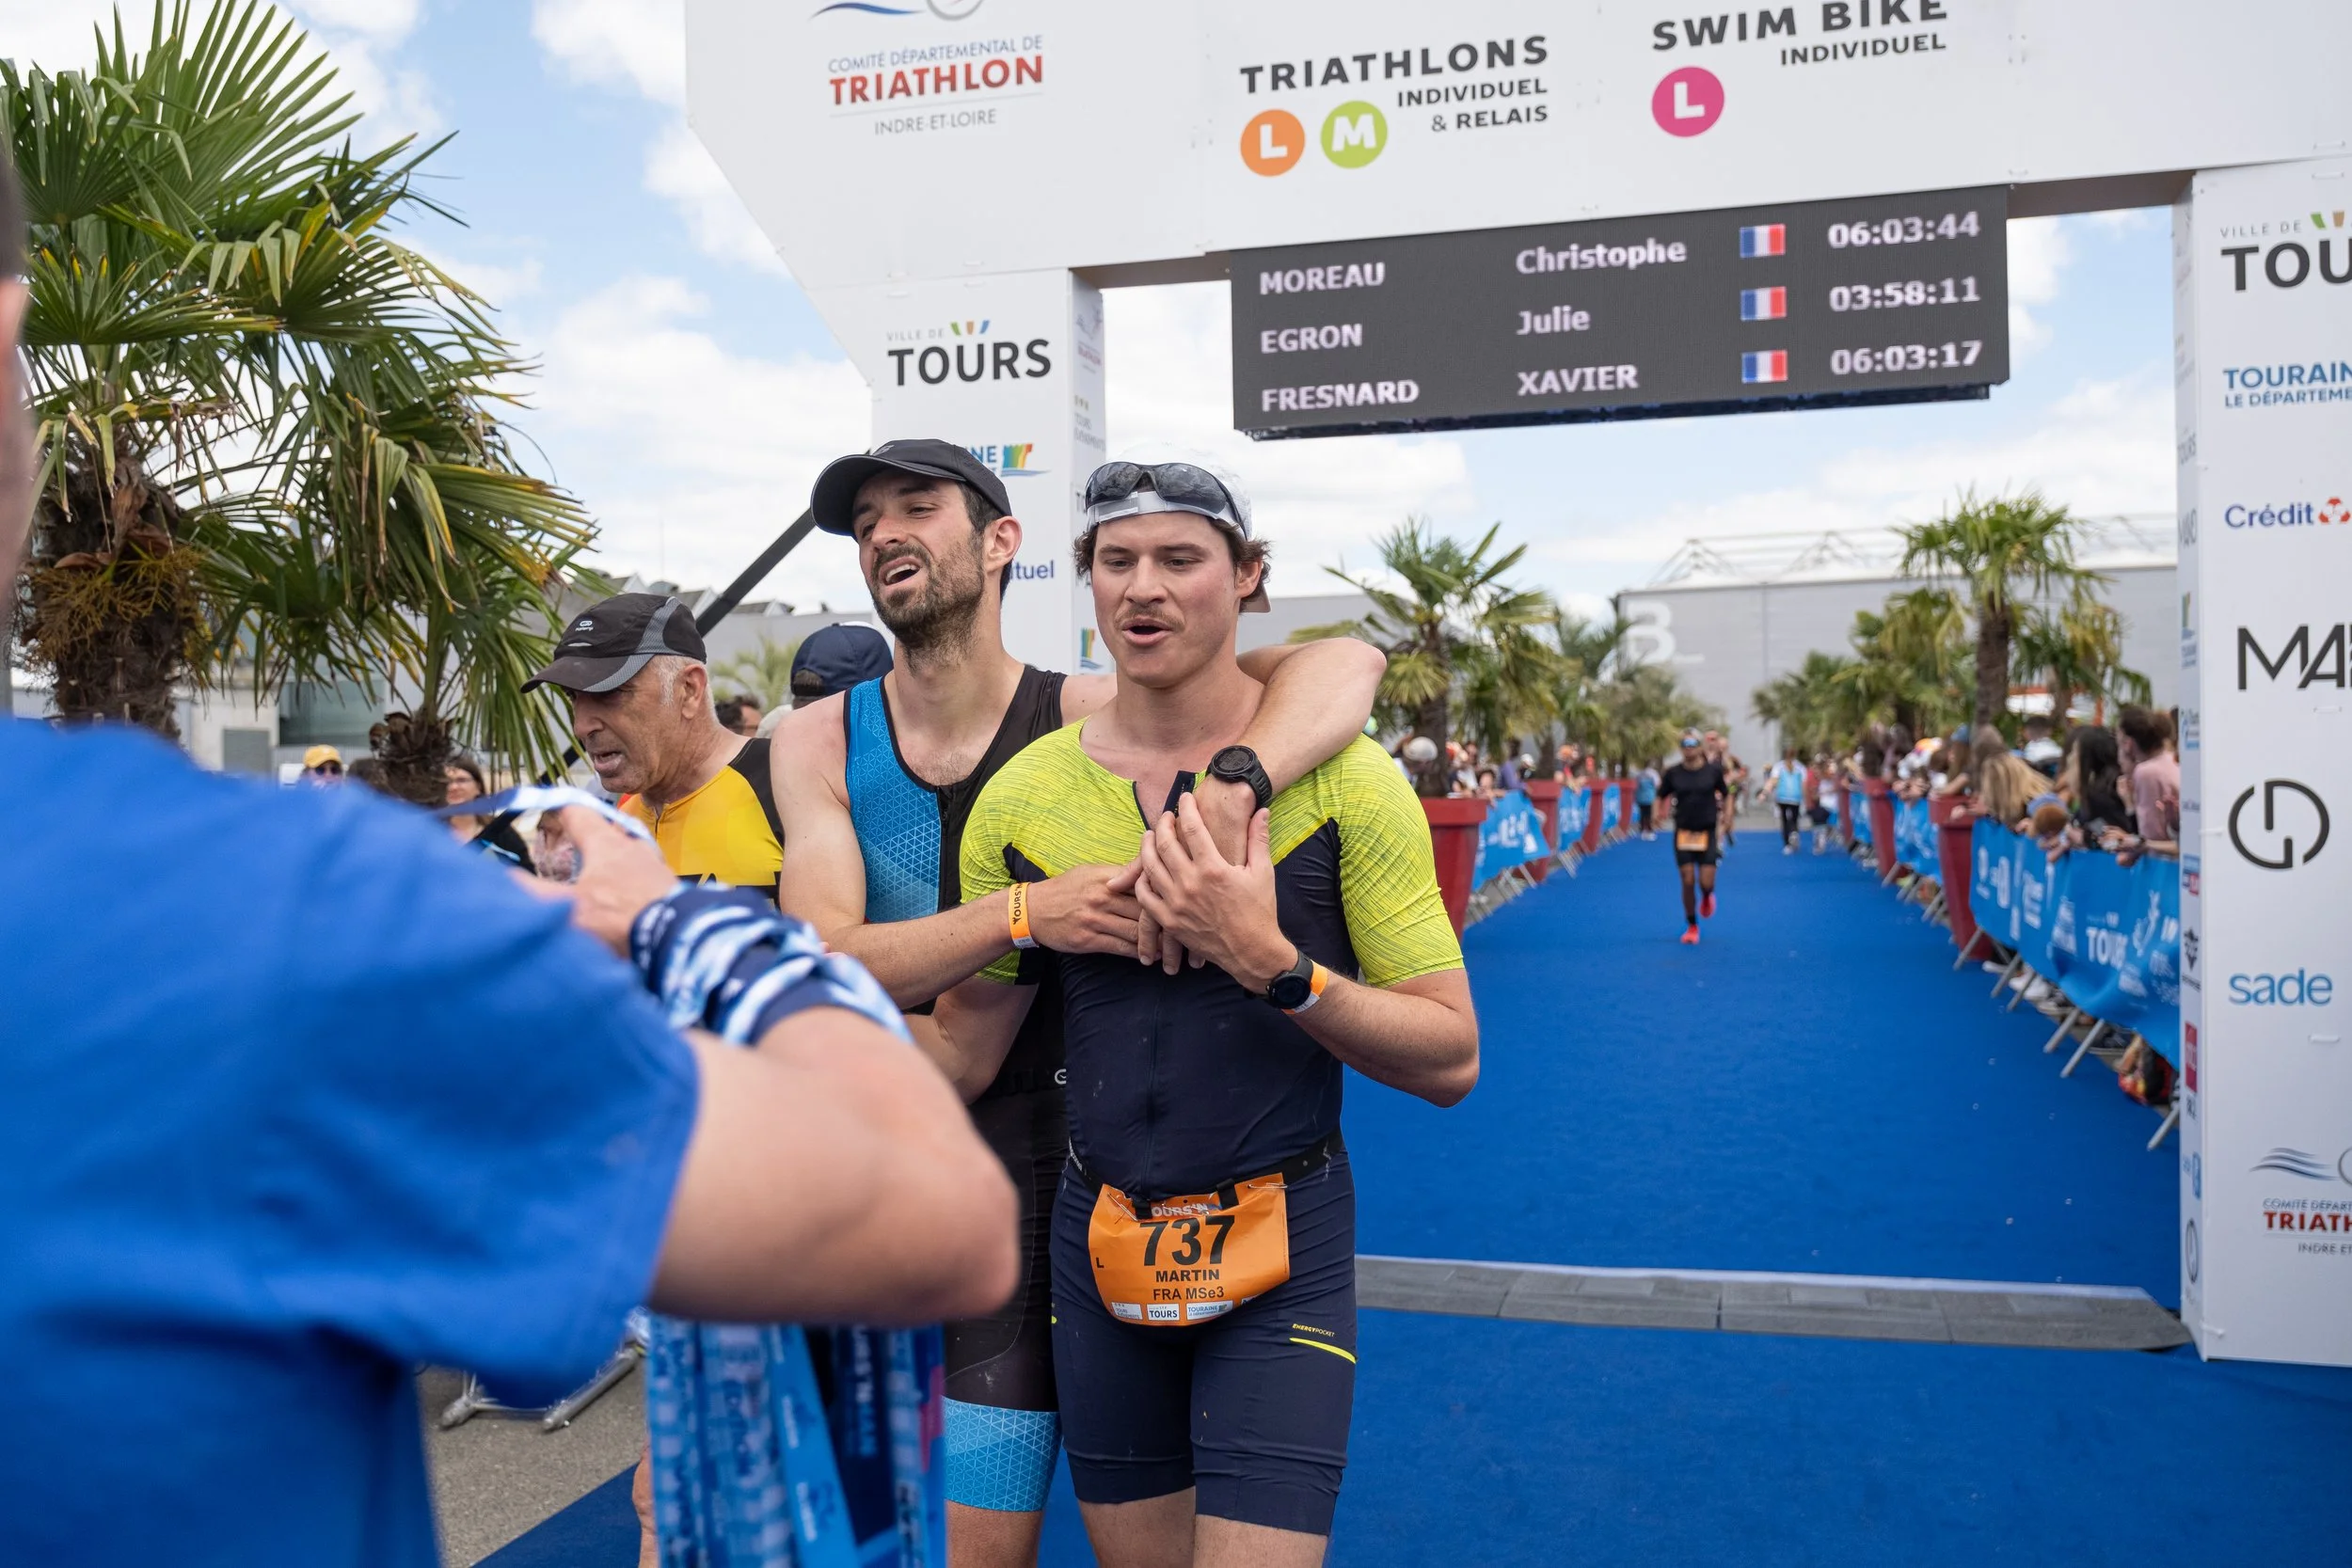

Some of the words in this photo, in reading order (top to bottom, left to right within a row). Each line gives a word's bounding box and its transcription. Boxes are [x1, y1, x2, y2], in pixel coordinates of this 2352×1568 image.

[1653, 8, 1796, 51] SWIM
[1822, 0, 1947, 32] BIKE
[828, 52, 885, 73] COMITÉ
[890, 38, 1016, 66] DÉPARTEMENTAL
[1022, 35, 1043, 51] DE
[1240, 35, 1548, 94] TRIATHLONS
[1781, 34, 1947, 65] INDIVIDUEL
[829, 55, 1043, 105] TRIATHLON
[1398, 78, 1548, 107] INDIVIDUEL
[1431, 115, 1448, 132] &
[1457, 105, 1548, 129] RELAIS
[1674, 82, 1705, 119] L
[1259, 123, 1288, 159] L
[1332, 113, 1376, 152] M
[2220, 223, 2269, 238] VILLE
[2280, 219, 2302, 234] DE
[1260, 261, 1385, 294] MOREAU
[1517, 238, 1687, 274] Christophe
[1828, 211, 1980, 248] 06:03:44
[1261, 324, 1362, 354] EGRON
[1517, 306, 1590, 335] Julie
[1829, 276, 1980, 312] 03:58:11
[886, 329, 922, 341] VILLE
[929, 328, 945, 340] DE
[887, 339, 1051, 386] TOURS
[1262, 379, 1420, 412] FRESNARD
[1518, 364, 1639, 396] XAVIER
[1831, 340, 1982, 375] 06:03:17
[2224, 393, 2244, 408] LE
[2224, 502, 2314, 529] Crédit
[2237, 623, 2352, 690] MA
[2229, 968, 2333, 1006] sade
[1138, 1214, 1235, 1267] 737
[1095, 1258, 1104, 1269] L
[1155, 1269, 1220, 1283] MARTIN
[1152, 1289, 1183, 1301] FRA
[1185, 1286, 1225, 1300] MSe3
[1150, 1309, 1178, 1319] TOURS
